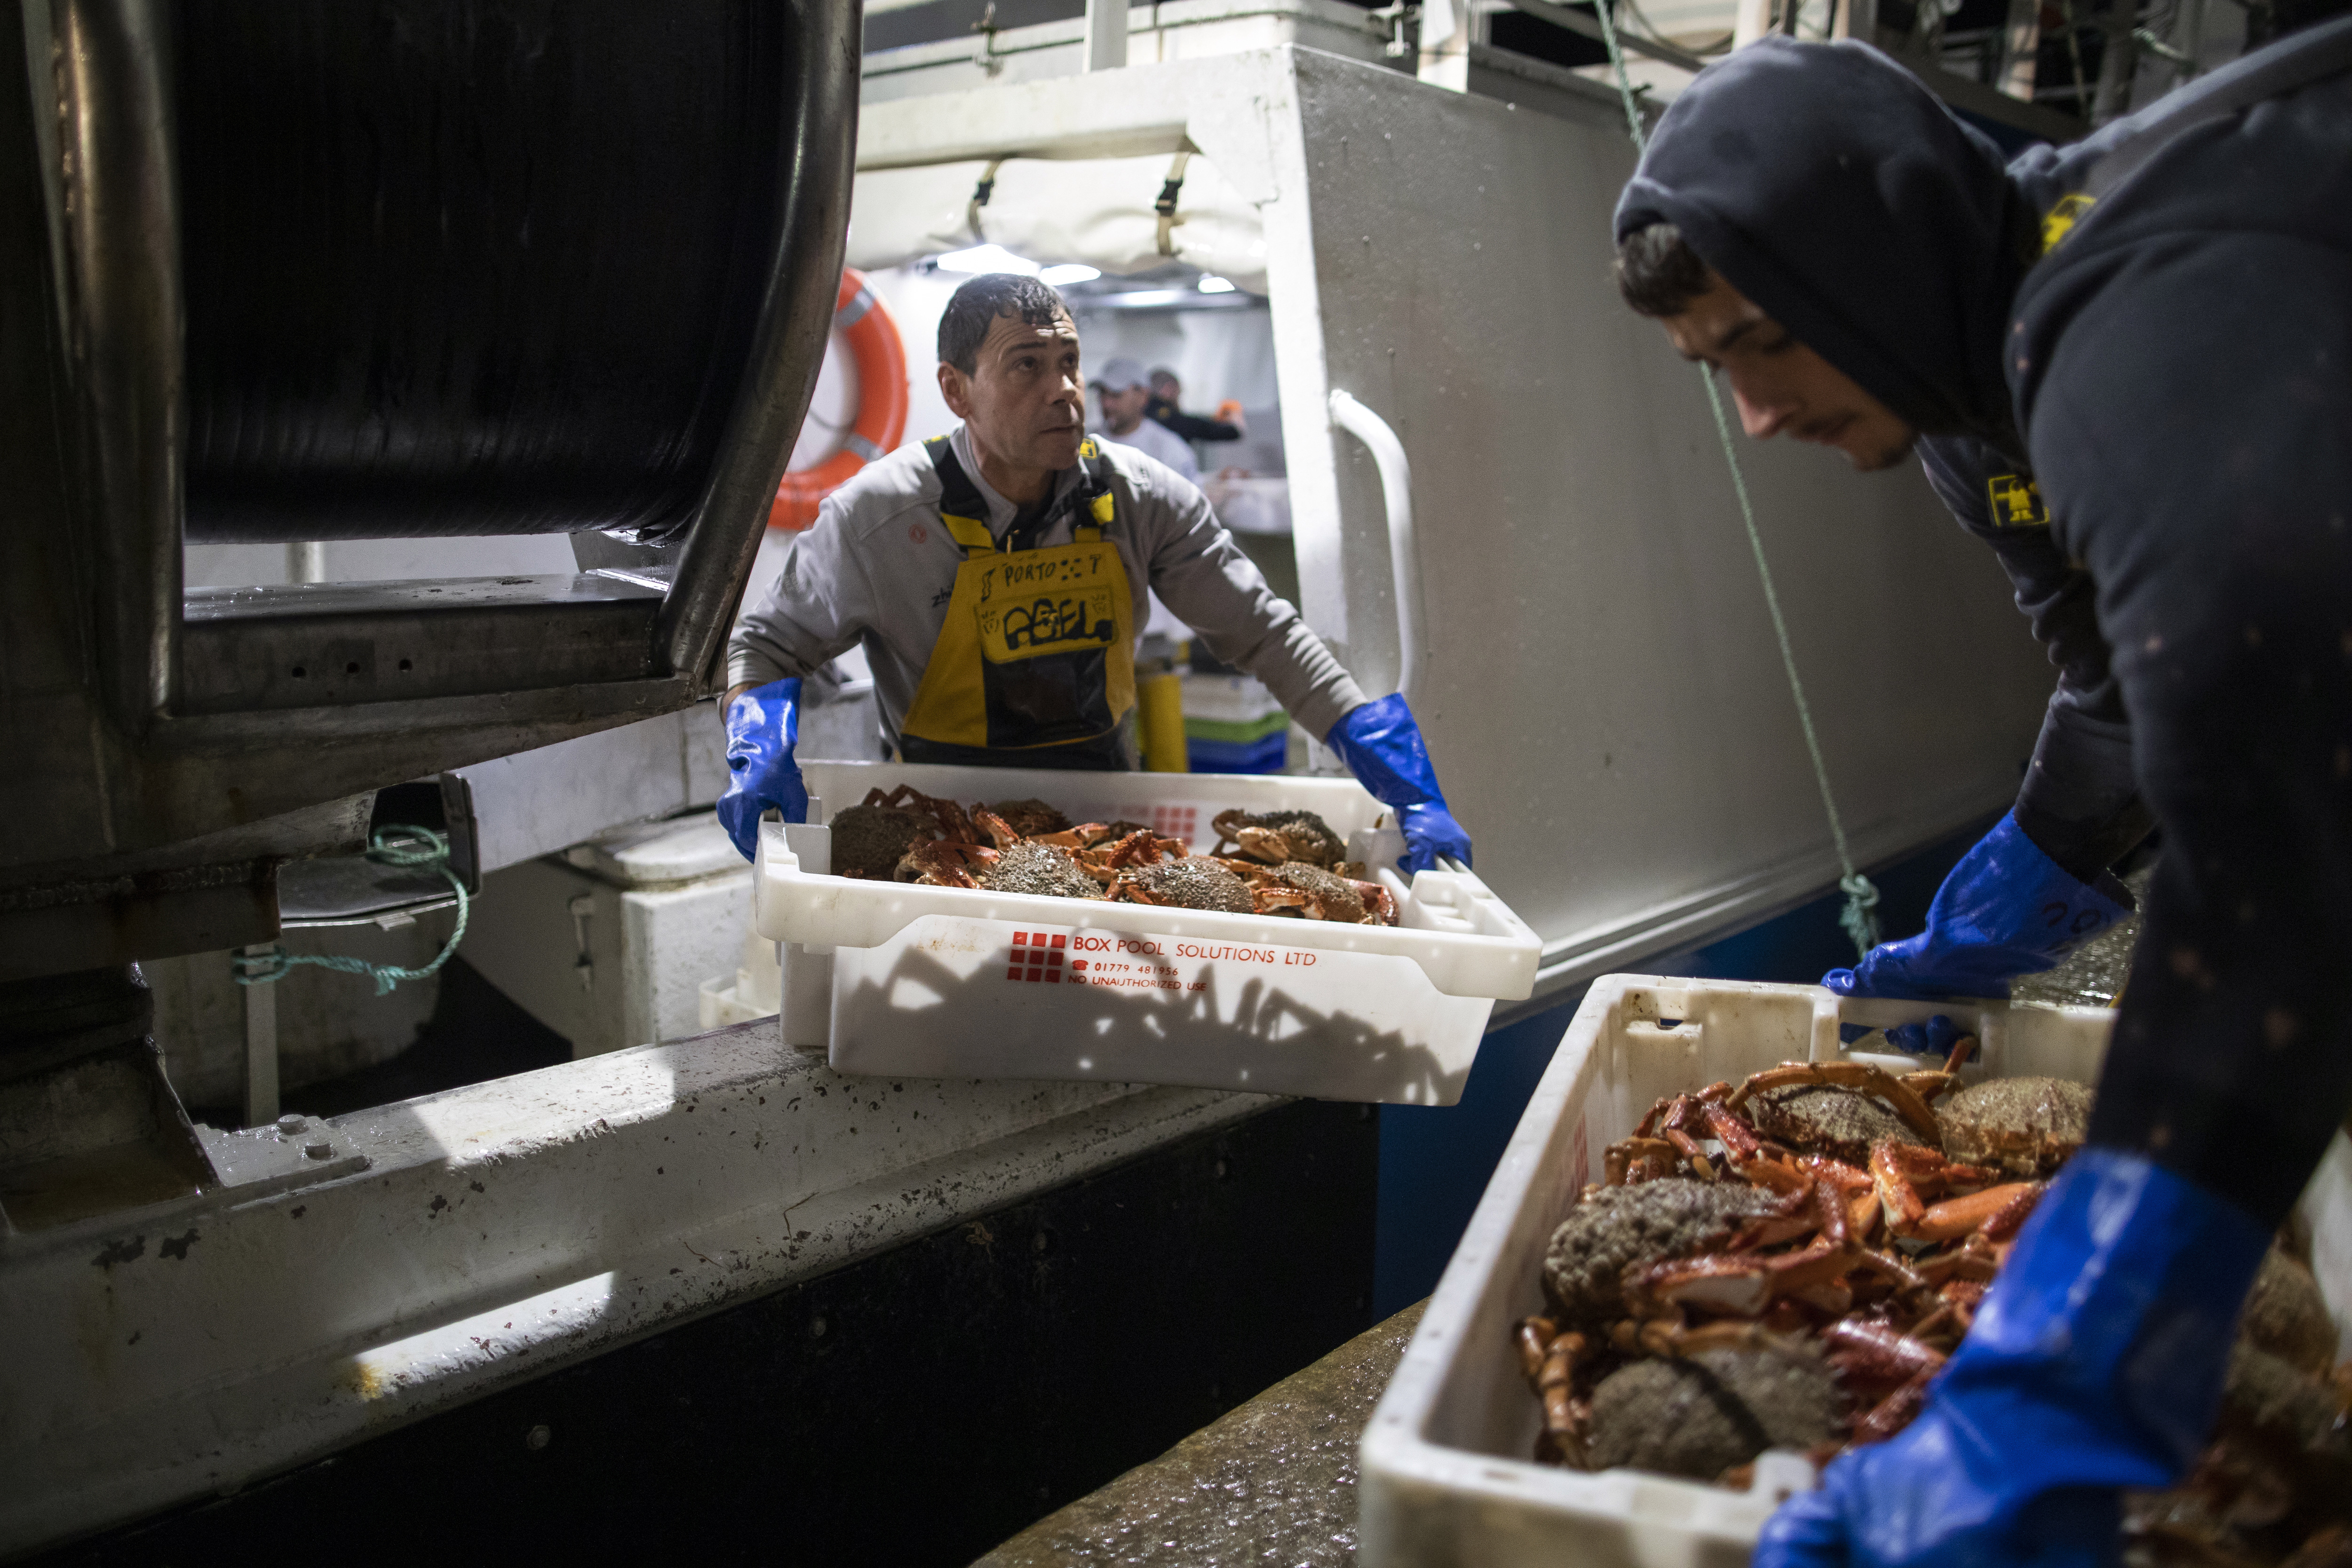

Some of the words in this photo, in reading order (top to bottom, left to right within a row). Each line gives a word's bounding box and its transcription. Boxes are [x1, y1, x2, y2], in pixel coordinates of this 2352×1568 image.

[1005, 562, 1056, 587] PORTO
[1073, 937, 1111, 952] BOX
[1117, 940, 1165, 955] POOL
[1176, 944, 1275, 963] SOLUTIONS
[1285, 952, 1316, 966] LTD
[1095, 963, 1129, 972] 01779
[1137, 966, 1178, 976] 481956
[1068, 975, 1087, 984] NO
[1092, 976, 1182, 990] UNAUTHORIZED
[1187, 982, 1207, 991] USE
